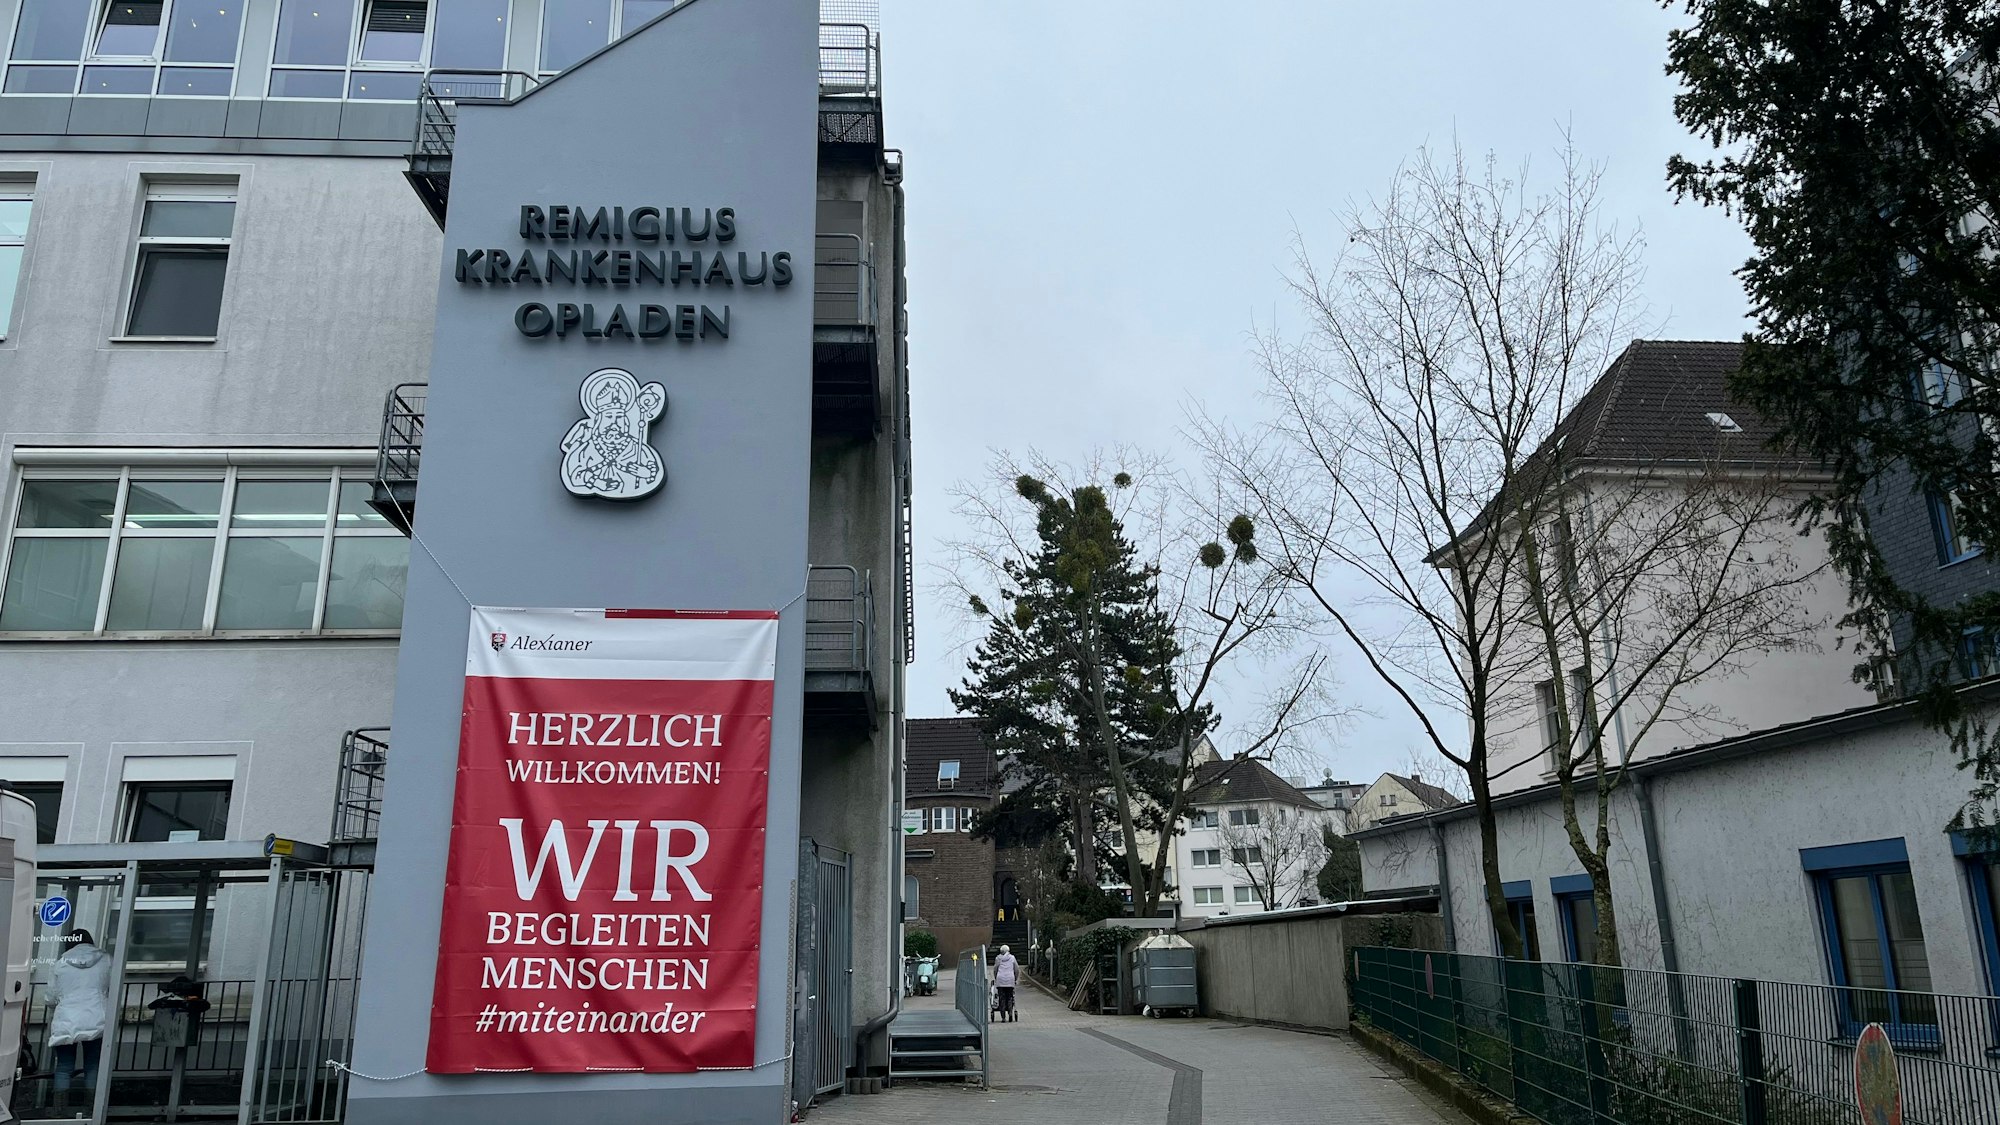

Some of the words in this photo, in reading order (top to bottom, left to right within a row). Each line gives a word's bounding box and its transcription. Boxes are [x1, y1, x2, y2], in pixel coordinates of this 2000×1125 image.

[519, 205, 737, 242] REMIGIUS
[455, 249, 793, 286] KRANKENHAUS
[514, 302, 730, 338] OPLADEN
[509, 633, 593, 651] Alexianer
[508, 712, 722, 748] HERZLICH
[506, 759, 721, 785] WILLKOMMEN!
[499, 818, 712, 901] WIR
[486, 911, 711, 946] BEGLEITEN
[481, 957, 709, 990] MENSCHEN
[475, 1002, 706, 1034] #miteinander
